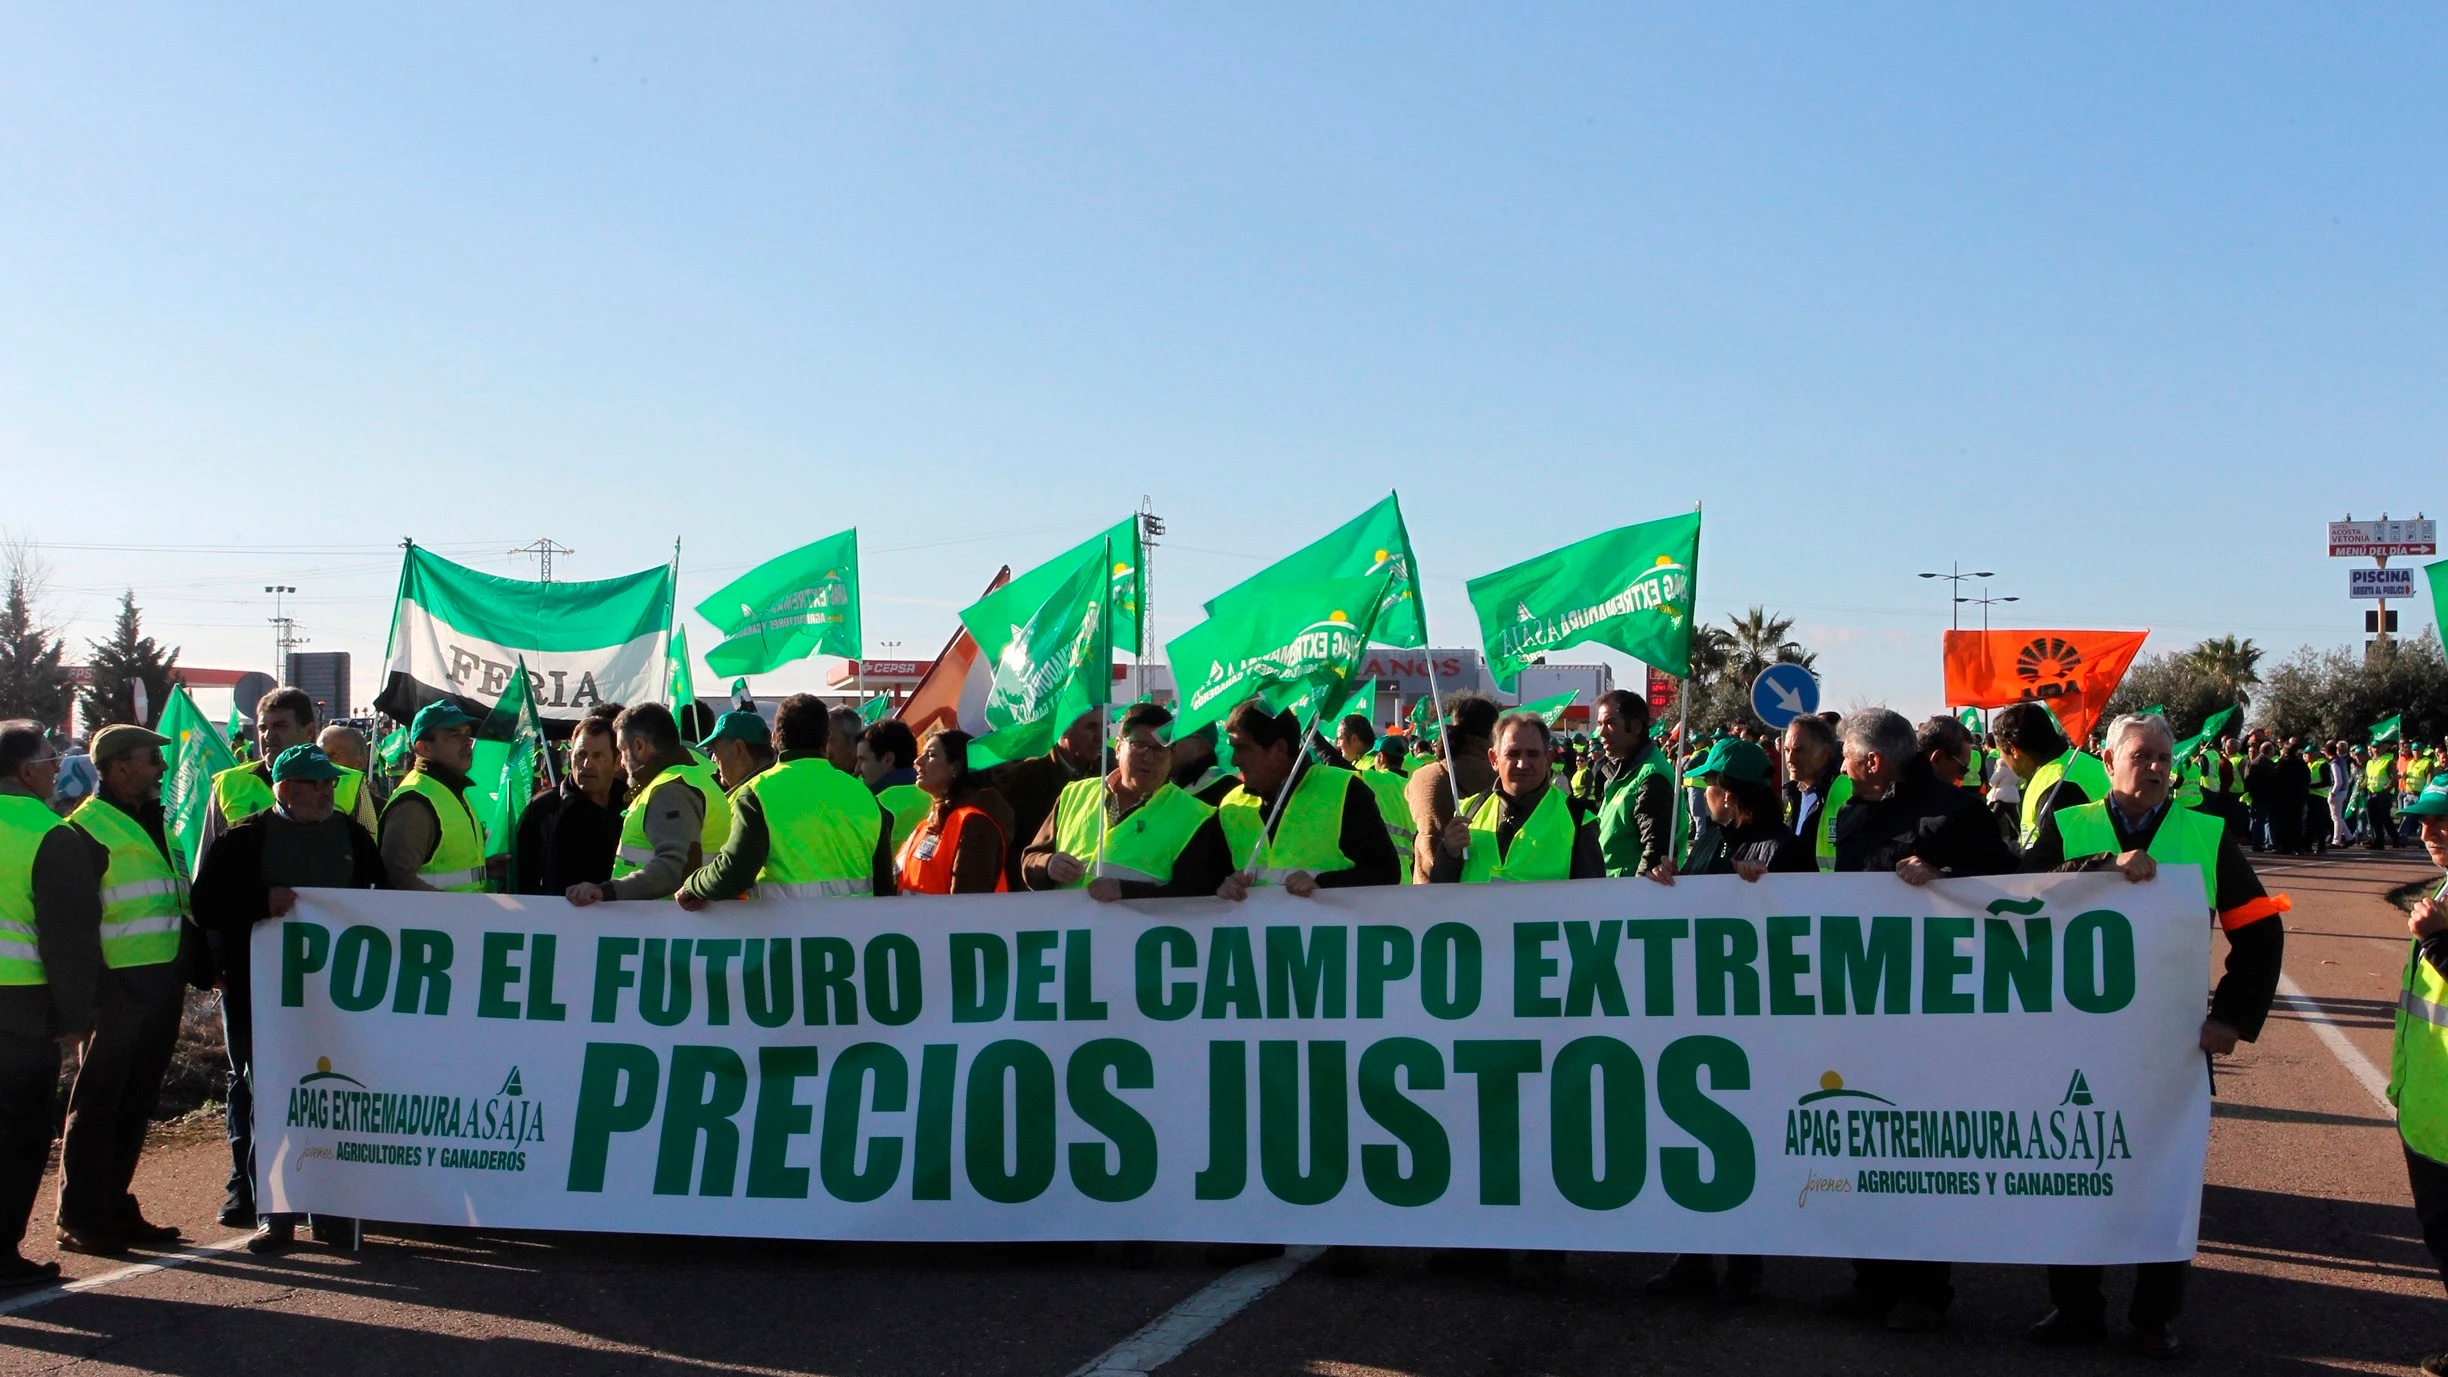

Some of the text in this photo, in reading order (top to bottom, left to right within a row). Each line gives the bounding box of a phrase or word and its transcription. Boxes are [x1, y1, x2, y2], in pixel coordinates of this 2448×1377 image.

[2332, 535, 2370, 543] VETONIA
[2335, 545, 2408, 556] MENÚ DEL DÍA
[2352, 570, 2411, 583] PISCINA
[2352, 586, 2375, 595] ABIERTA
[2375, 586, 2382, 595] AL
[446, 644, 604, 707] FERIA
[874, 661, 916, 674] CEPSA
[281, 896, 2136, 1028] POR EL FUTURO DEL CAMPO EXTREMEÑO
[286, 1087, 546, 1151] APAG EXTREMADURA ASAJA
[567, 1034, 1757, 1214] PRECIOS JUSTOS
[335, 1140, 423, 1167] AGRICULTORES
[426, 1146, 437, 1167] Y
[439, 1147, 527, 1173] GANADEROS
[1784, 1108, 2133, 1172] APAG EXTREMADURA ASAJA
[1798, 1166, 2114, 1209] jóvenes AGRICULTORES Y GANADEROS
